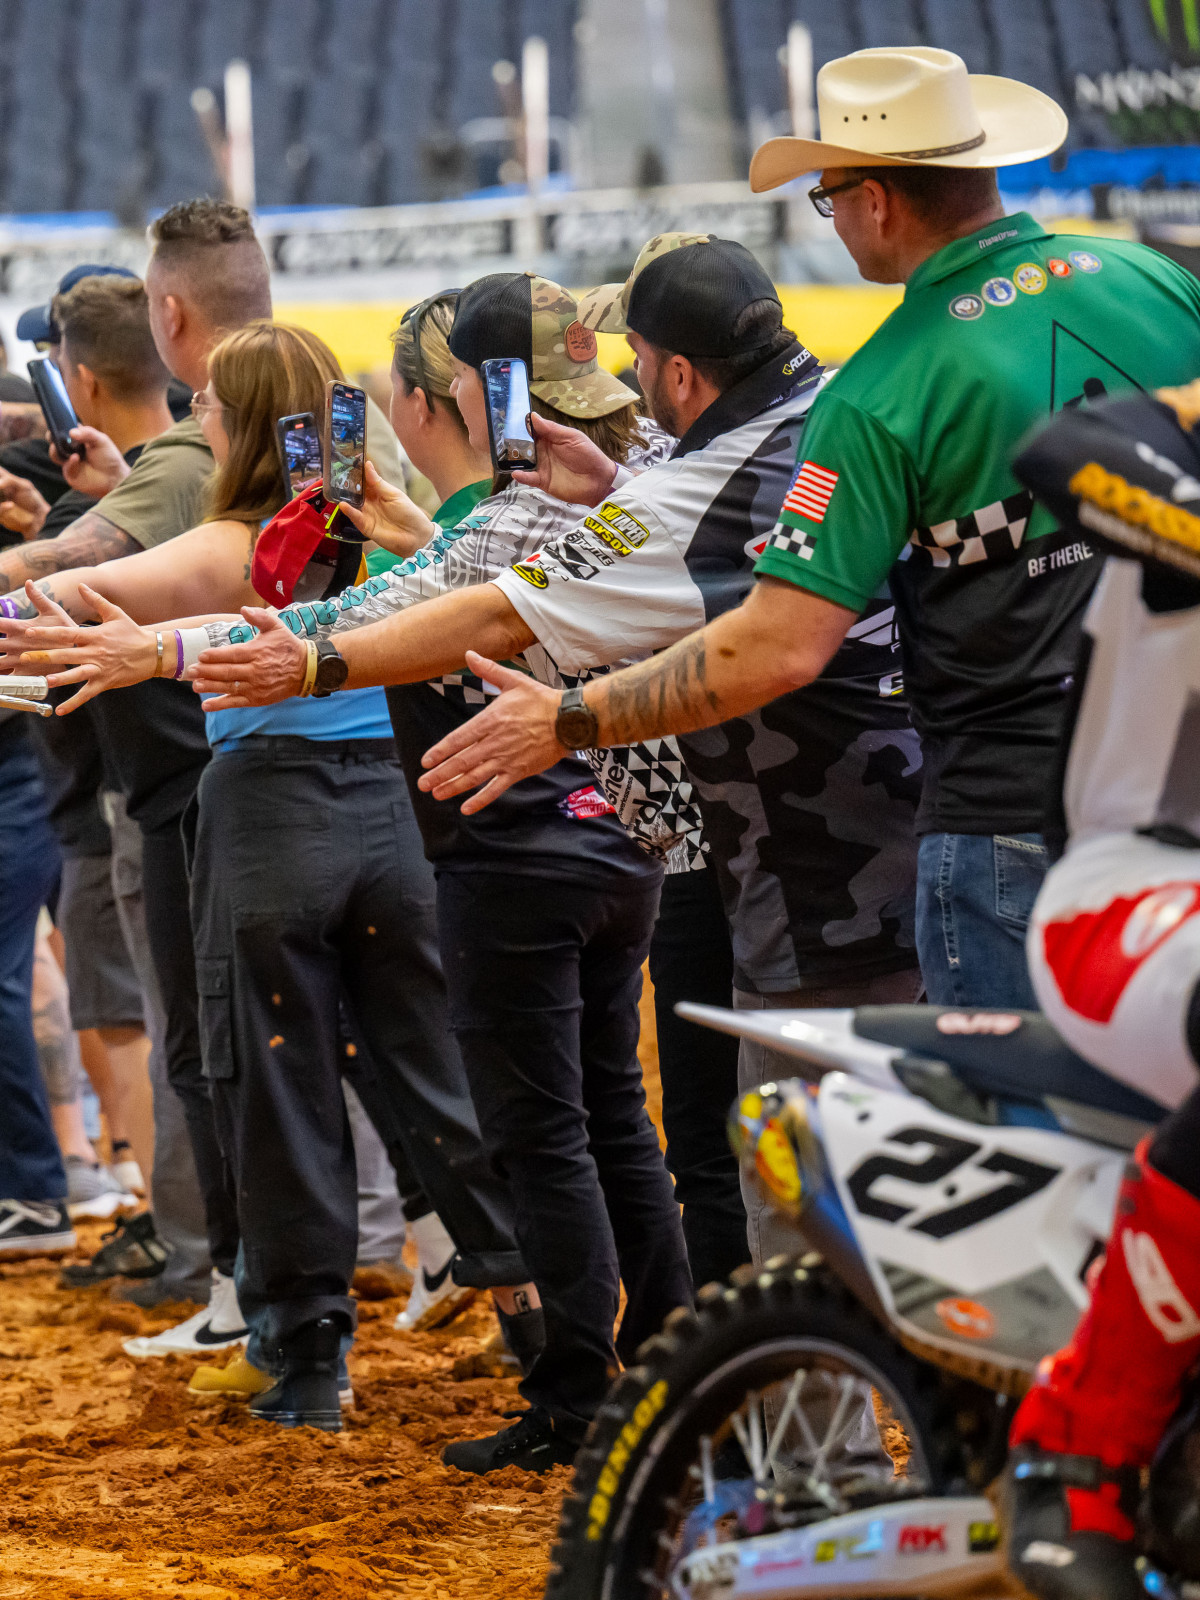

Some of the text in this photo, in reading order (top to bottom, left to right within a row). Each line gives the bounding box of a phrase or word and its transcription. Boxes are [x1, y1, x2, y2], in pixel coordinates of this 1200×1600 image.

[1027, 541, 1094, 578] BE THERE
[228, 599, 340, 645] aloe
[847, 1127, 1062, 1239] 27
[588, 1380, 669, 1529] DUNLOP
[898, 1523, 948, 1555] RK
